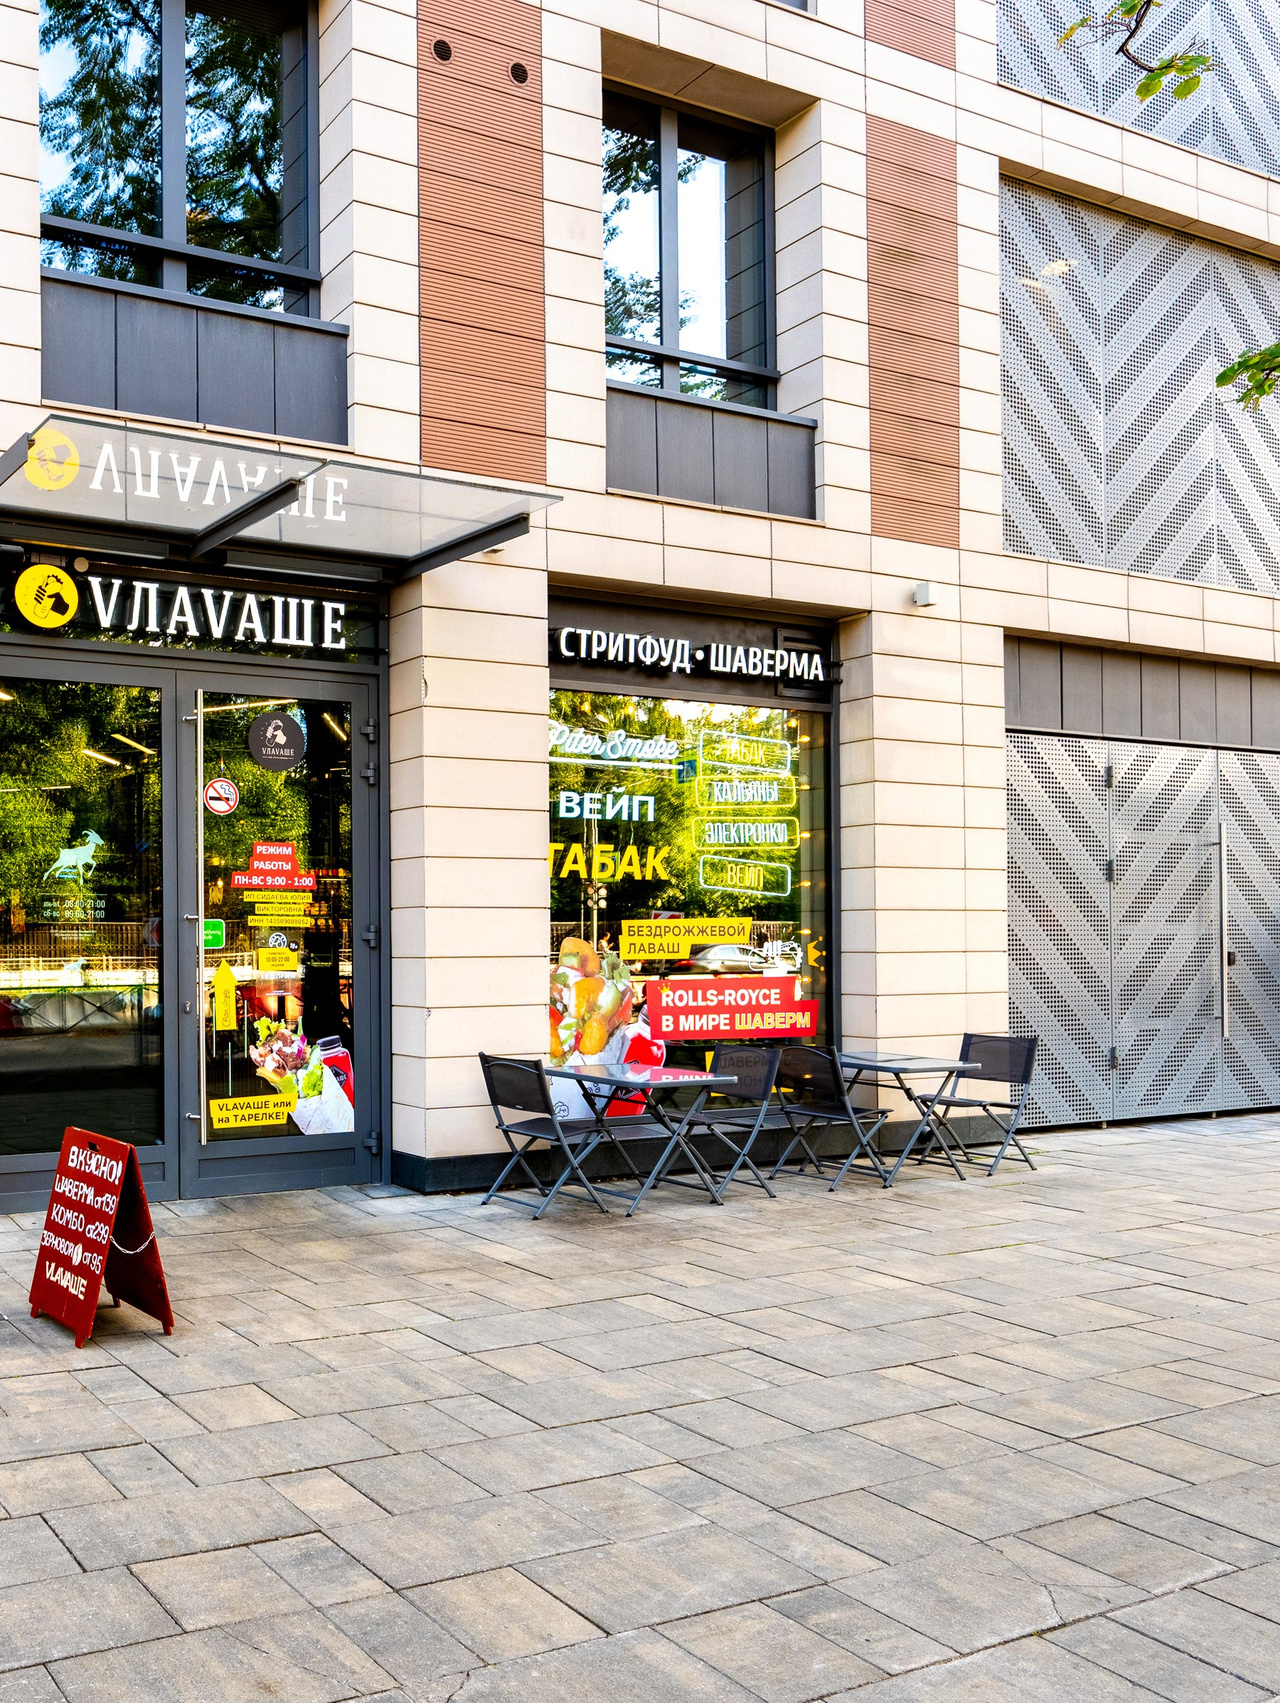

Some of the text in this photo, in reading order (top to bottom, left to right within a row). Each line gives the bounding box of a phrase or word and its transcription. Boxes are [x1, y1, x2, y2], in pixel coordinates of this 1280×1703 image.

[559, 627, 824, 681] СТРИТФУД ШАВЕРМА
[606, 729, 679, 759] Smoke
[726, 739, 766, 764] ТАБАК
[713, 781, 779, 803] КАЛЬЯНЫ
[558, 787, 655, 822] ВЕЙП
[705, 822, 788, 844] ЭЛЕКТРОНКИ
[256, 846, 292, 855] РЕЖИМ
[549, 842, 672, 880] ТАБАК
[254, 861, 292, 870] РАБОТЫ
[727, 864, 764, 888] ВЕЙП
[234, 876, 264, 884] ПН-ВС
[266, 876, 286, 885] 9:00
[294, 877, 314, 886] 1:00
[627, 922, 746, 938] БЕЗДРОЖЖЕВОЙ
[627, 942, 680, 955] ЛАВАШ
[661, 989, 781, 1007] ROLLS-ROYCE
[662, 1012, 811, 1032] В МИРЕ ШАВЕРМ
[218, 1112, 285, 1124] на ТАРЕЛКЕ!
[68, 1146, 123, 1186] ВКУСНО!
[54, 1174, 95, 1206] ШАВЕРМА
[50, 1202, 85, 1232] КОМБО
[40, 1230, 75, 1258] ЗЕРНОВОЙ
